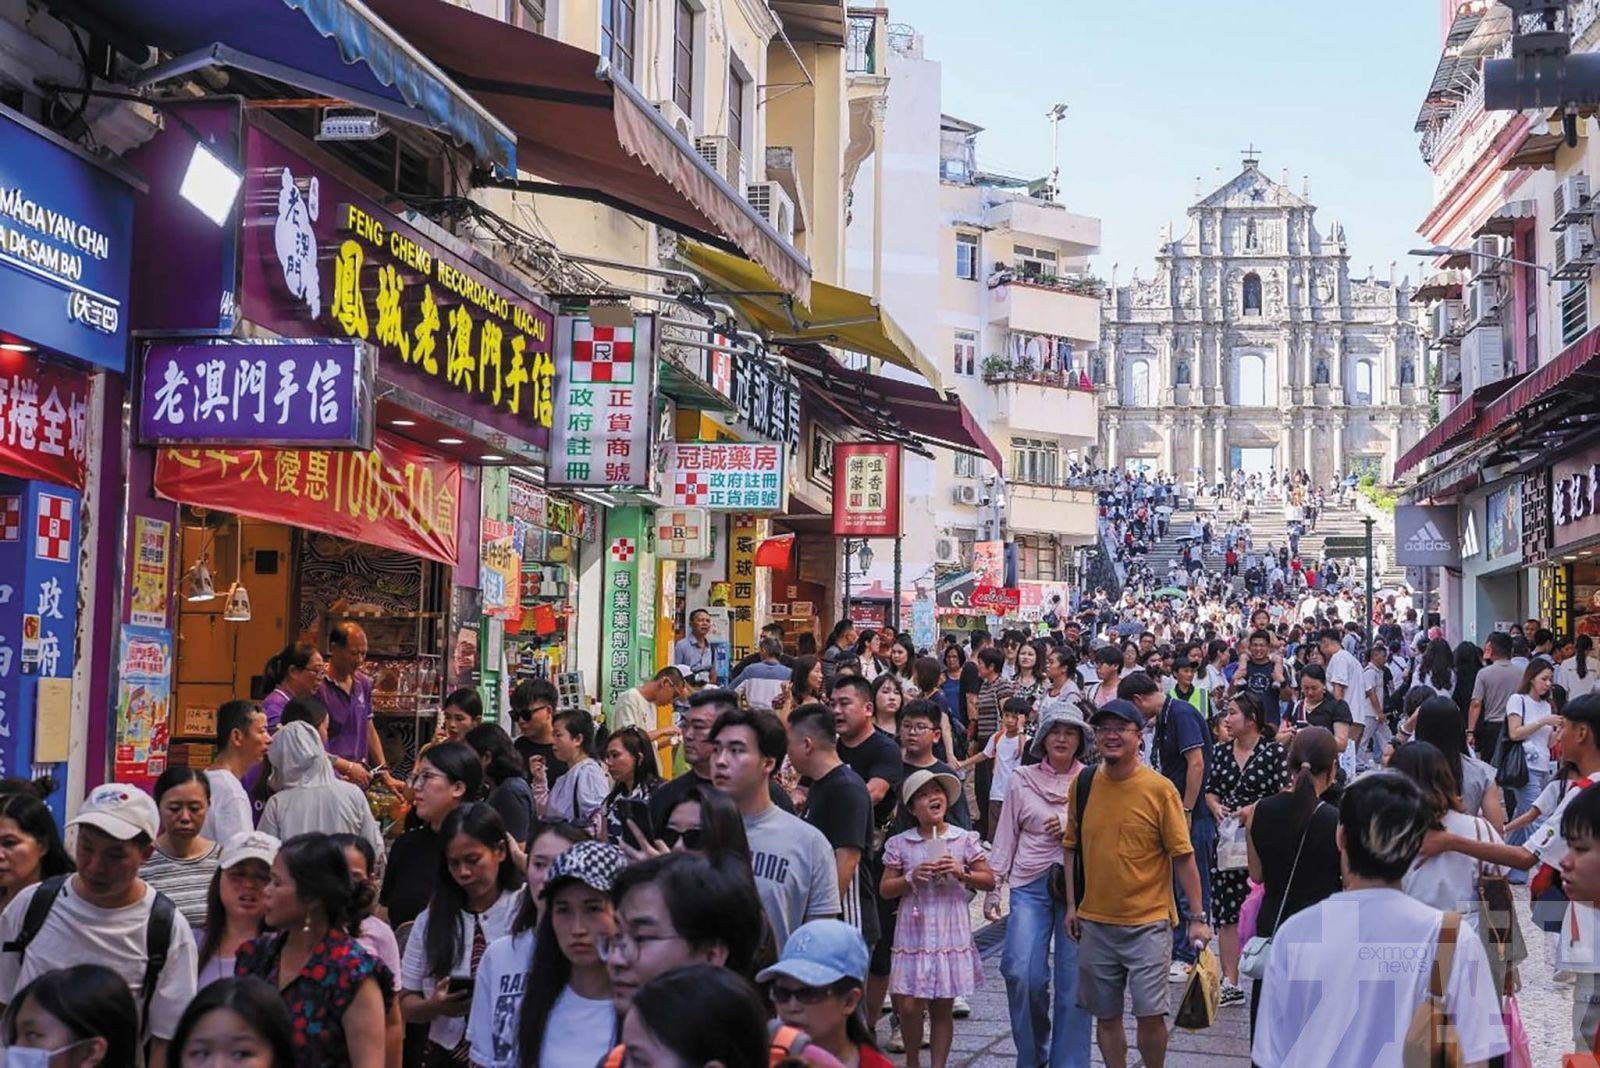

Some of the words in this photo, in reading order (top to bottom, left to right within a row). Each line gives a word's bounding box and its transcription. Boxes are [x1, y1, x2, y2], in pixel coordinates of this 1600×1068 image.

[10, 230, 28, 258] DA
[30, 239, 59, 272] SAM
[61, 254, 82, 280] BA)
[47, 210, 75, 244] YAN
[78, 225, 108, 259] CHAI
[349, 205, 384, 247] FENG
[389, 232, 432, 276] CHENG
[437, 260, 509, 321] RECORDACAO
[513, 307, 547, 343] MACAU
[68, 291, 118, 333] (大三巴)
[331, 239, 556, 430] 鳳城老澳門手信
[153, 359, 342, 425] 老澳門手信
[566, 388, 594, 482] 政府註冊
[604, 389, 634, 483] 正貨商號
[677, 446, 778, 471] 冠誠藥房
[708, 490, 778, 507] 正貨商號
[709, 473, 778, 489] 政府註冊
[672, 528, 686, 539] R
[1404, 540, 1451, 551] adidas
[735, 536, 753, 622] 環球西藥
[751, 851, 790, 885] ONG
